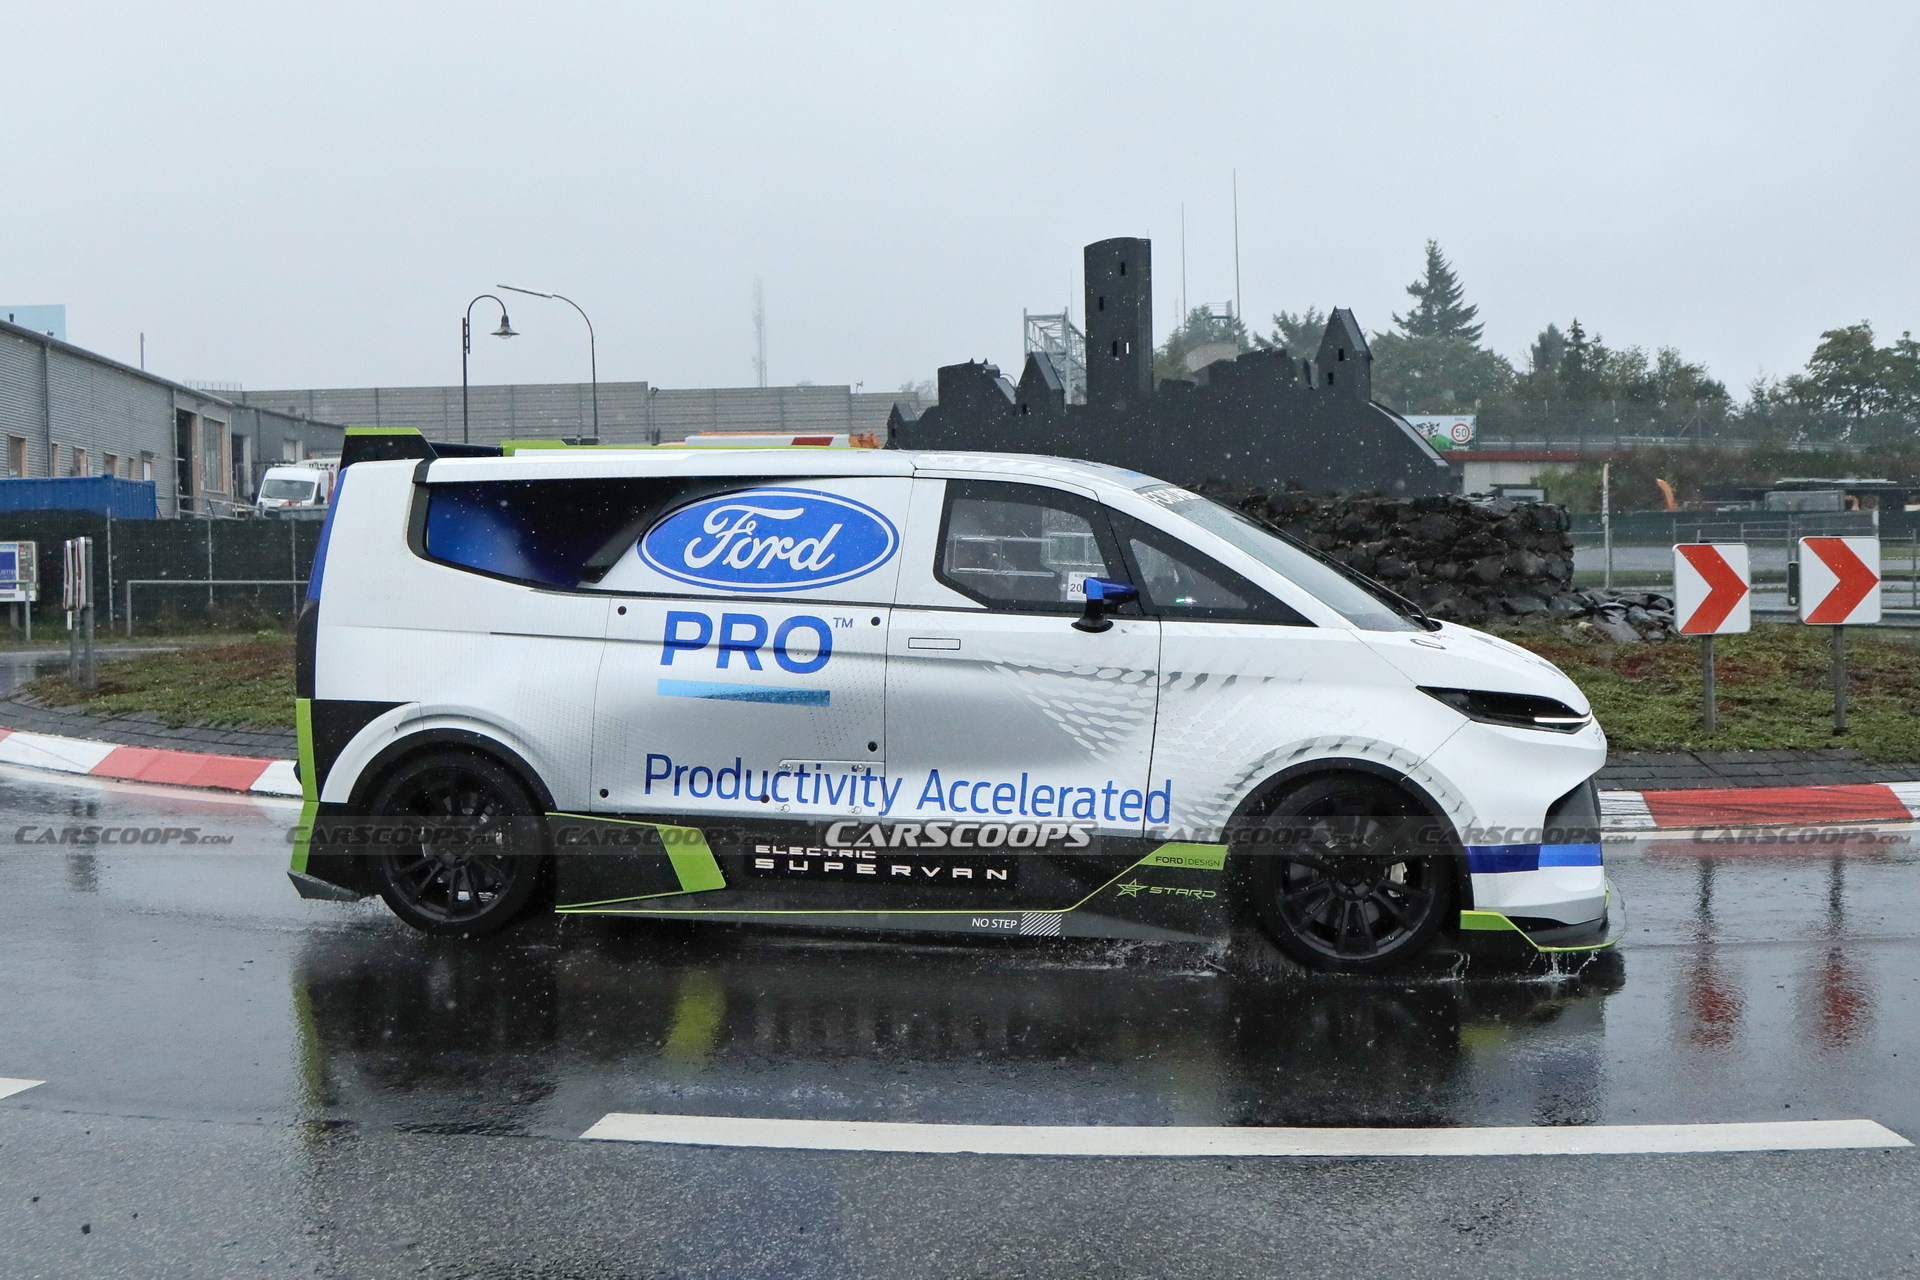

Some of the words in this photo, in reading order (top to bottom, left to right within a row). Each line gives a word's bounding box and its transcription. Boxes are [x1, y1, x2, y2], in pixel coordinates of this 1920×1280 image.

[1455, 428, 1467, 437] 50
[683, 504, 844, 571] Ford
[660, 610, 833, 674] PRO
[644, 753, 903, 817] Productivity
[916, 768, 1172, 824] Accelerated
[755, 845, 877, 859] ELECTRIC
[1155, 856, 1184, 865] FORD
[1187, 858, 1220, 867] DESIGN
[755, 858, 1007, 880] SUPERVAN
[1149, 886, 1217, 900] STARD
[971, 917, 989, 928] NO
[991, 918, 1018, 929] STEP
